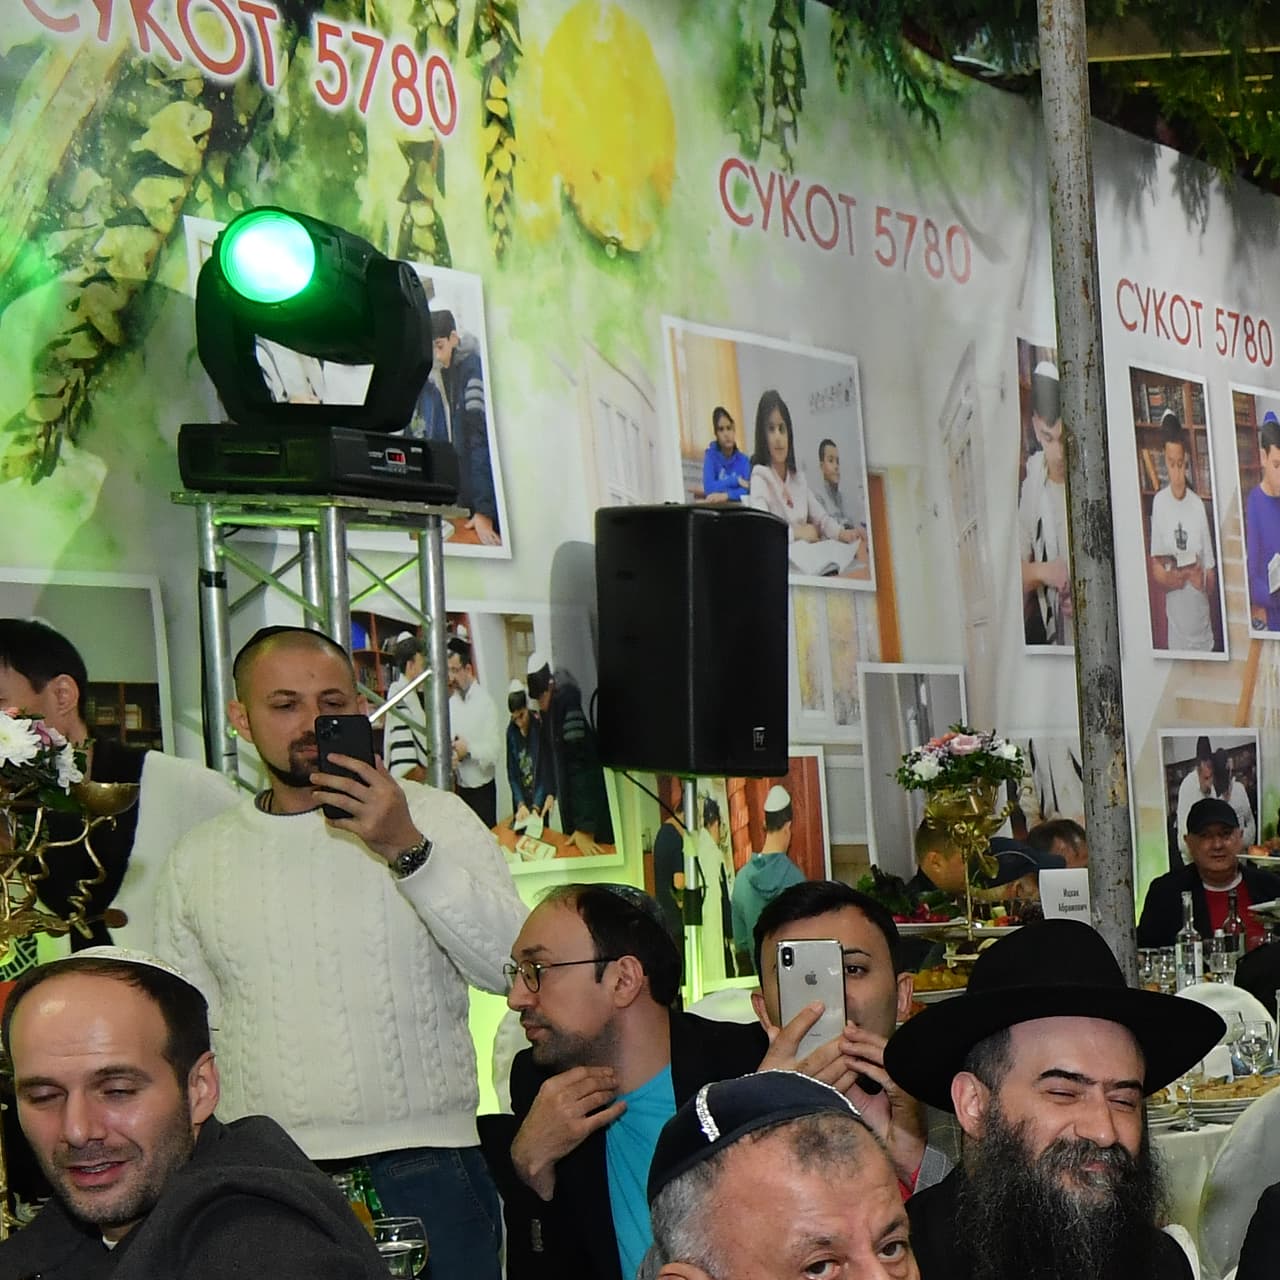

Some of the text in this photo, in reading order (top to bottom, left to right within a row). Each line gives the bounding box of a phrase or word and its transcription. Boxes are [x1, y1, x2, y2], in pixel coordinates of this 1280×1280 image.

[315, 21, 457, 137] 5780
[719, 157, 971, 284] СУКОТ 5780
[1116, 278, 1273, 367] СУКОТ 5780
